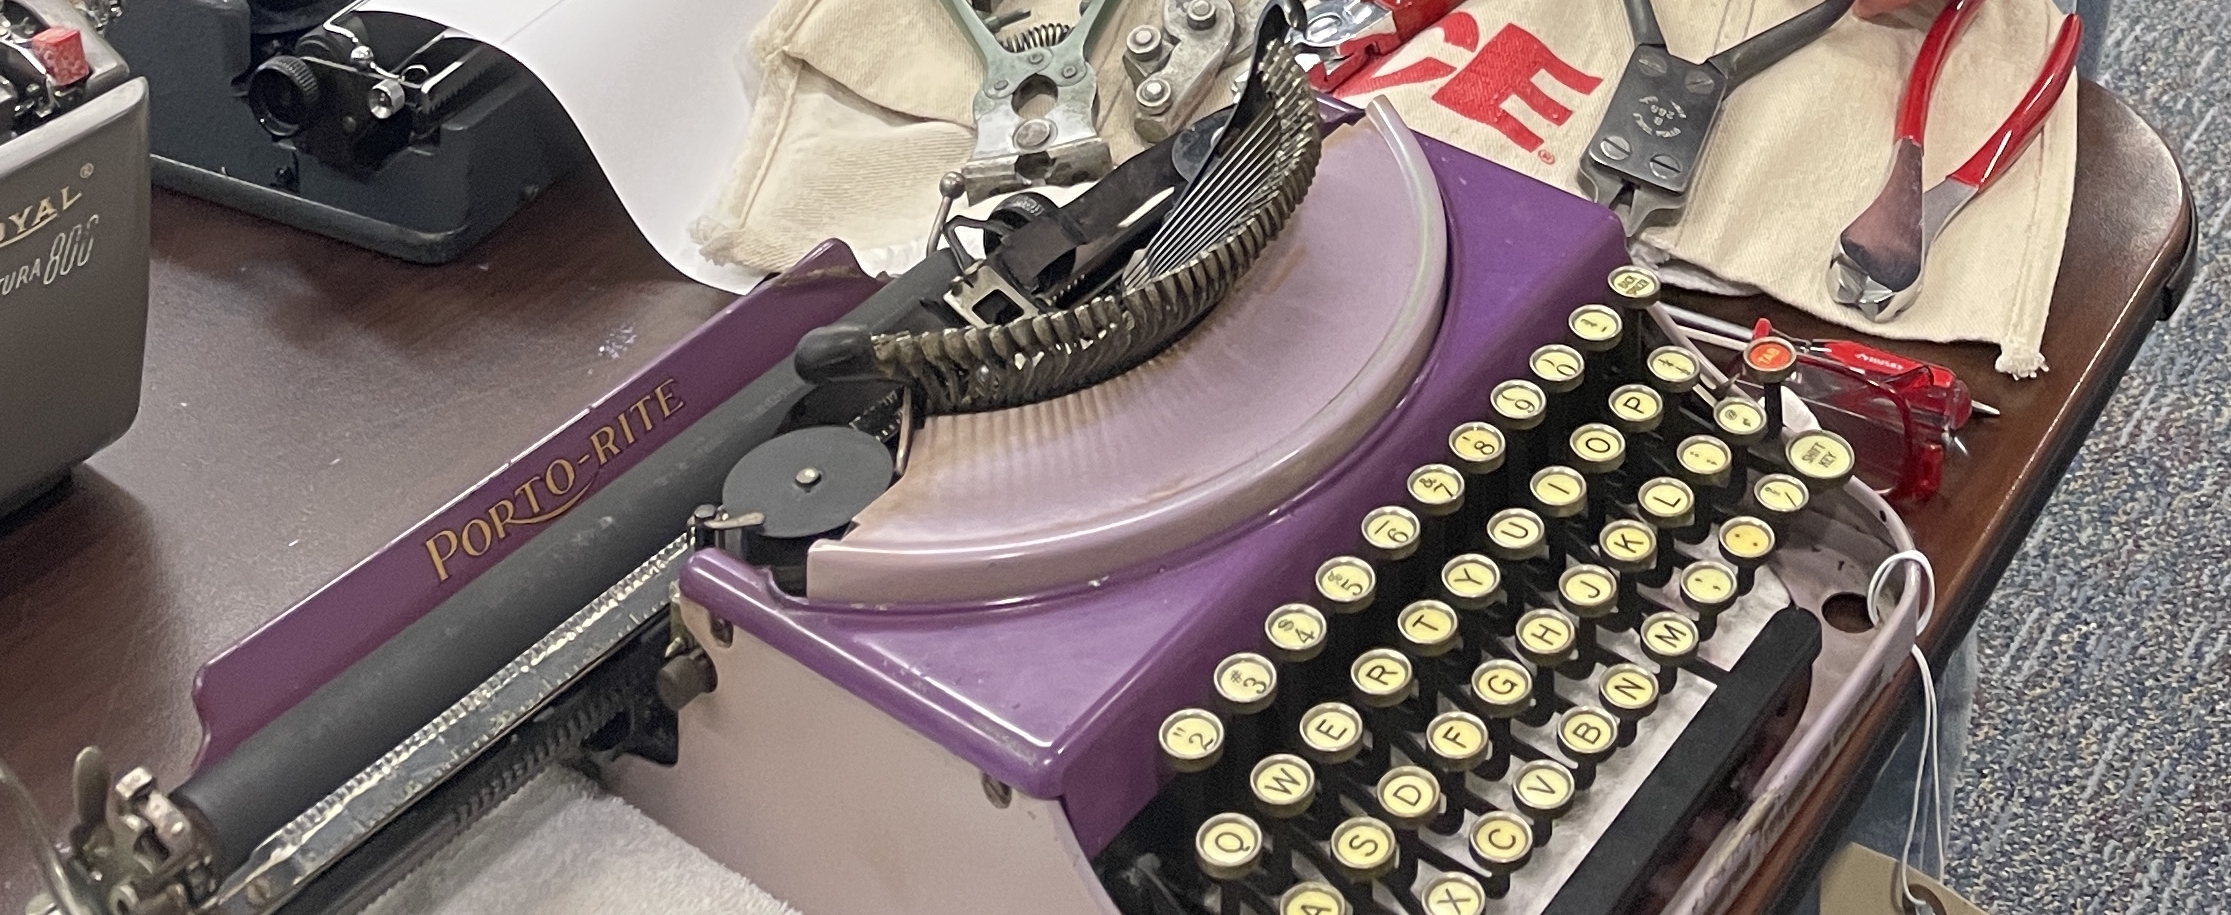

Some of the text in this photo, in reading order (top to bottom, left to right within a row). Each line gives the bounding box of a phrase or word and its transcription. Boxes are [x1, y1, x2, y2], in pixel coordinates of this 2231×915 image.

[0, 186, 83, 241] YAL
[1758, 347, 1780, 364] TAB
[1515, 399, 1536, 414] 9
[1623, 396, 1645, 414] P
[1474, 440, 1495, 455] 8
[1585, 437, 1611, 454] O
[1802, 442, 1826, 464] SHIFT
[1818, 451, 1838, 469] KEY
[425, 378, 685, 582] PORTO-RITE
[1434, 482, 1454, 498] 7
[1653, 495, 1682, 509] L
[1387, 527, 1409, 543] 6
[1500, 521, 1529, 539] U
[1613, 533, 1644, 553] K
[1453, 568, 1484, 586] Y
[1340, 579, 1363, 596] 5
[1580, 579, 1601, 599] J
[1412, 614, 1439, 632] T
[1295, 628, 1316, 644] 4
[1530, 623, 1562, 646] H
[1654, 623, 1687, 649] M
[1366, 664, 1399, 686] R
[1487, 674, 1519, 695] G
[1243, 677, 1267, 694] 3
[1614, 677, 1646, 701] N
[1314, 718, 1348, 741] E
[1442, 726, 1468, 749] F
[1572, 722, 1602, 745] B
[1188, 732, 1214, 751] 2
[1264, 767, 1301, 795] W
[1526, 774, 1556, 795] V
[1392, 783, 1422, 807] D
[1214, 831, 1251, 854] Q
[1348, 834, 1379, 857] S
[1487, 828, 1517, 850] C
[1437, 888, 1472, 915] X
